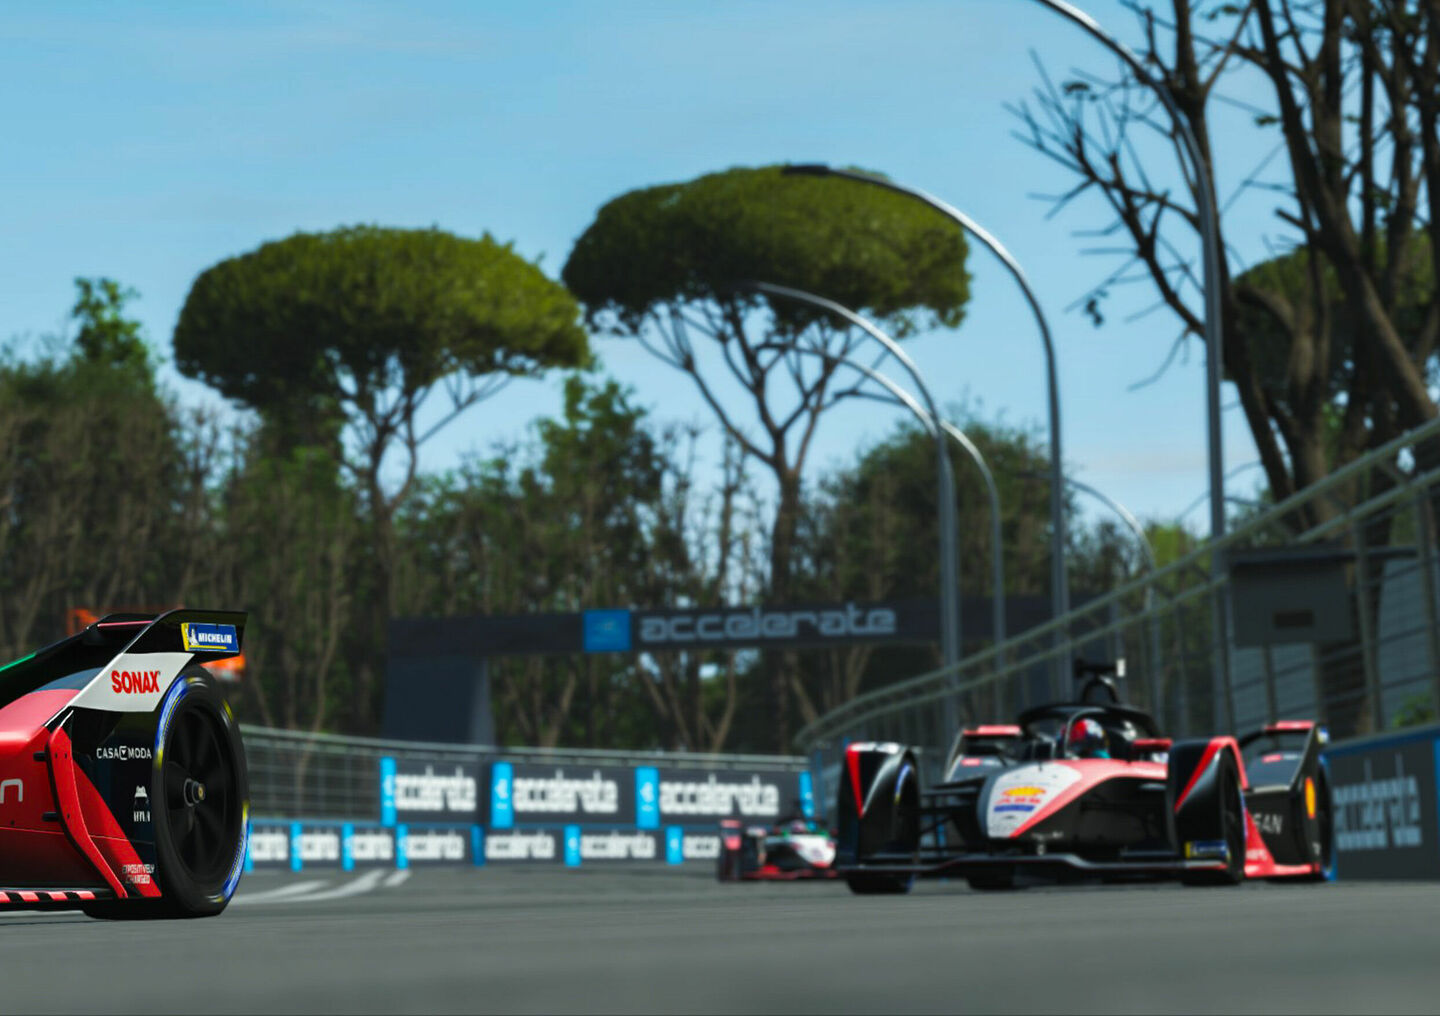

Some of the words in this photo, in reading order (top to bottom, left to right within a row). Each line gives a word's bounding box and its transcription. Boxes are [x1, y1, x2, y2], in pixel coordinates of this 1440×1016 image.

[639, 602, 897, 642] accelerate
[198, 632, 233, 644] MICHELIN
[111, 670, 160, 694] SONAX
